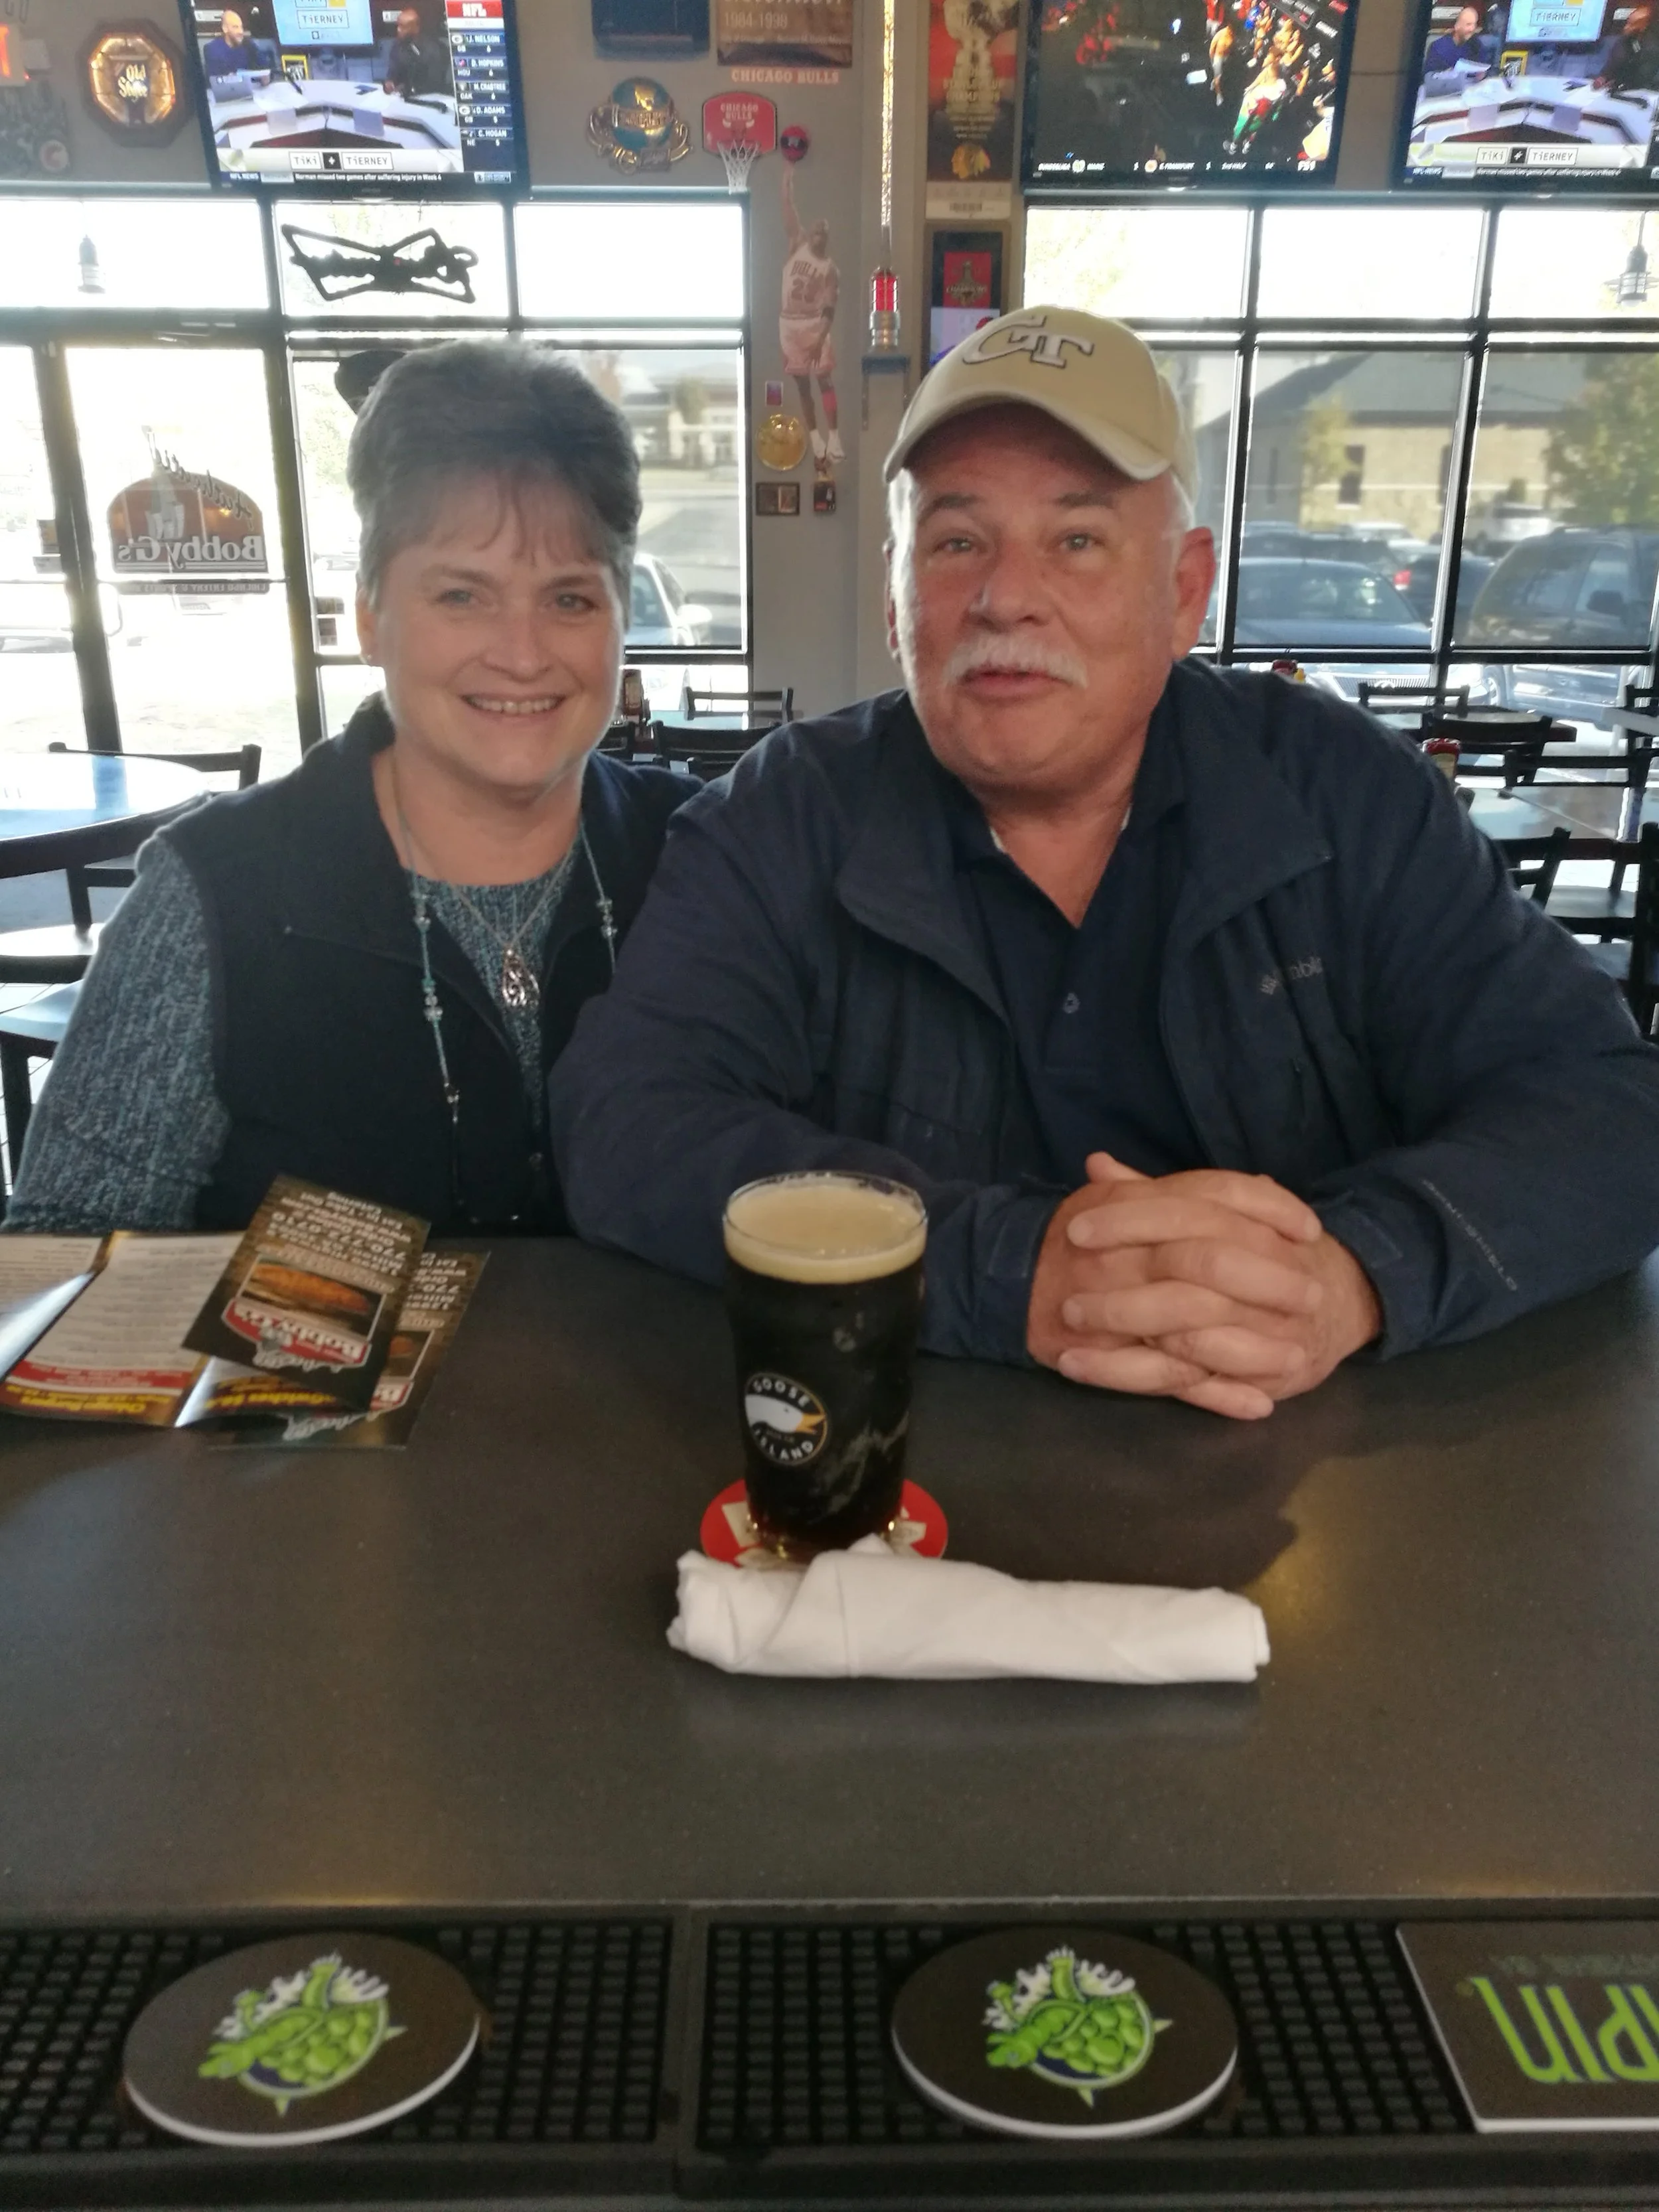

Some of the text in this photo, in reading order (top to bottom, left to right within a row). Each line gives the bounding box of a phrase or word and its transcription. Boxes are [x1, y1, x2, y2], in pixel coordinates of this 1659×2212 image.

[462, 3, 486, 17] NFL
[731, 69, 839, 84] CHICAGO BULLS
[720, 103, 758, 113] CHICAGO
[1297, 161, 1316, 171] FS1
[963, 315, 1094, 369] GT
[282, 1318, 363, 1359] Bobby
[753, 1378, 810, 1408] GOOSE
[754, 1428, 814, 1461] ISLAND
